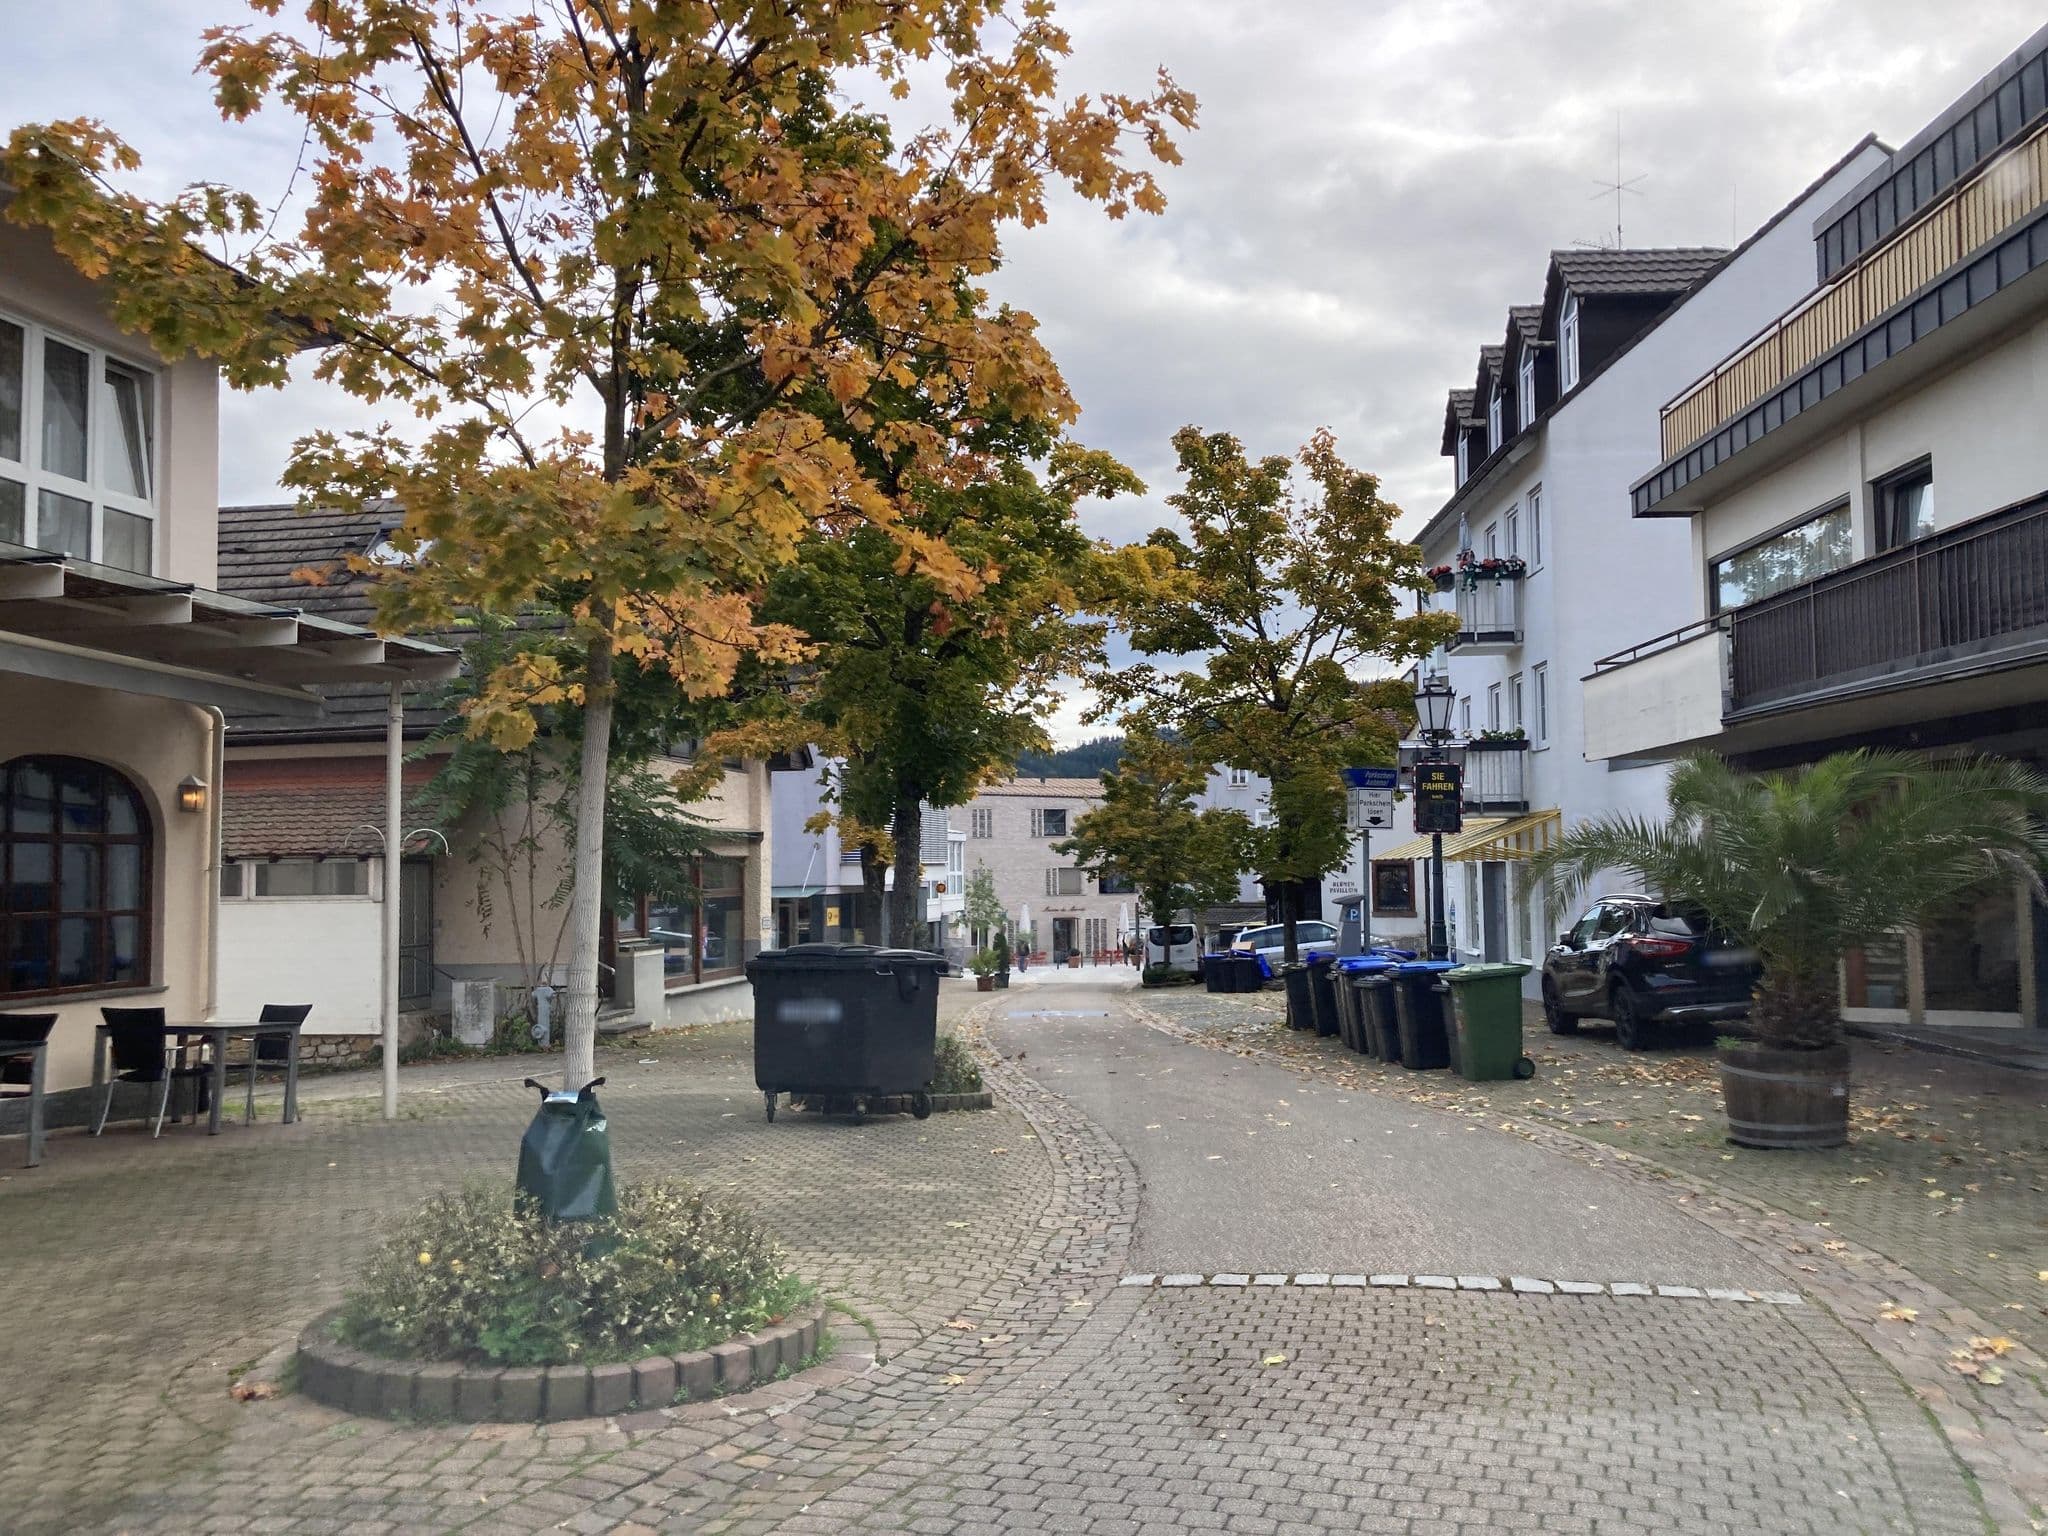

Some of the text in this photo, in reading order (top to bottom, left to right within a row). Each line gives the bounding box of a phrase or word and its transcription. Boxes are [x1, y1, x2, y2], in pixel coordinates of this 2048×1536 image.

[1431, 772, 1445, 781] SIE
[1422, 782, 1454, 791] FAHREN
[1359, 799, 1391, 807] Parkschein
[1350, 908, 1359, 921] P
